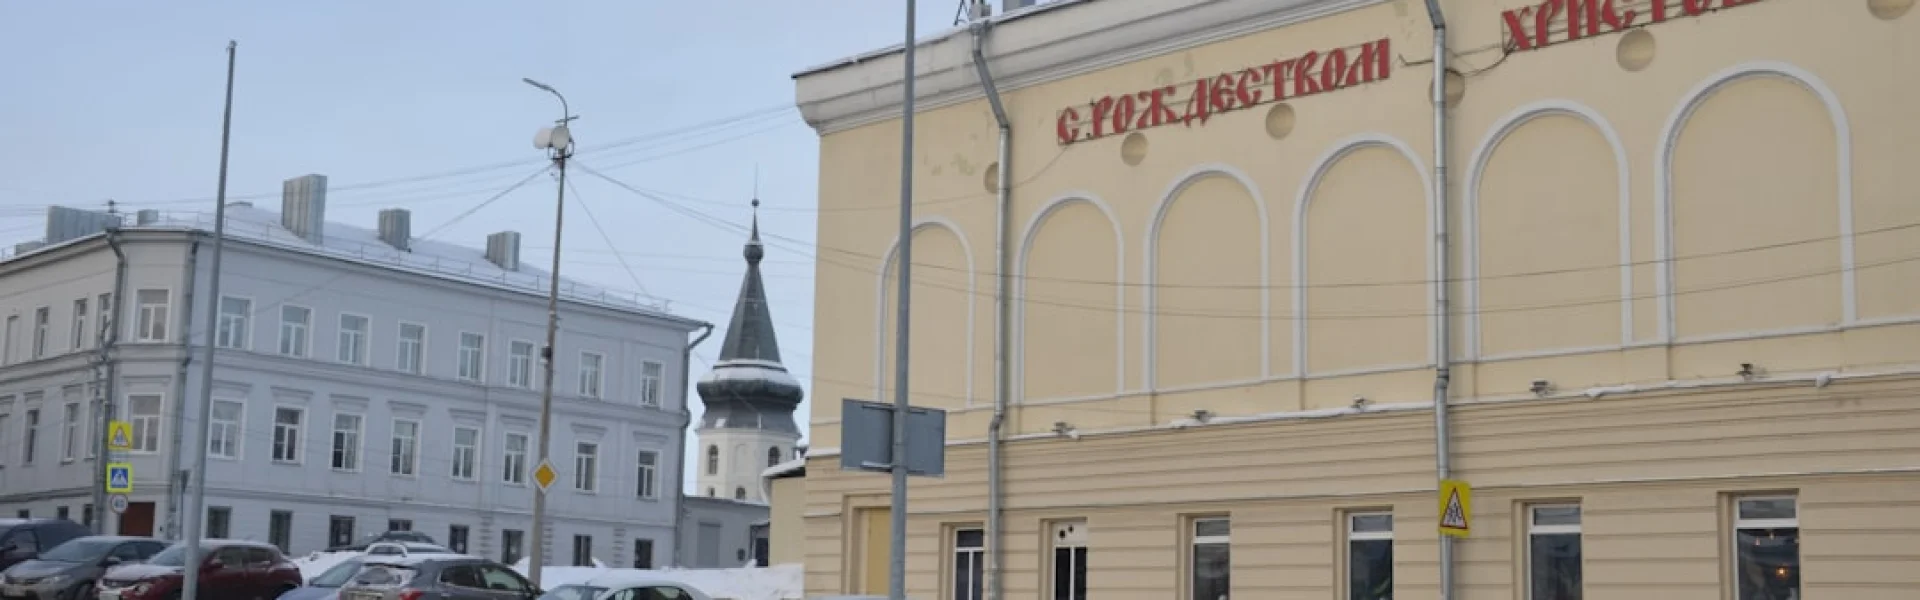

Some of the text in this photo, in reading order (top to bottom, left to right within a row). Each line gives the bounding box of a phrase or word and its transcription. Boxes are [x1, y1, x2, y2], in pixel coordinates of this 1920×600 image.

[1502, 0, 1754, 50] ХРИС
[1056, 37, 1390, 143] С РОЖДЕСТВОМ
